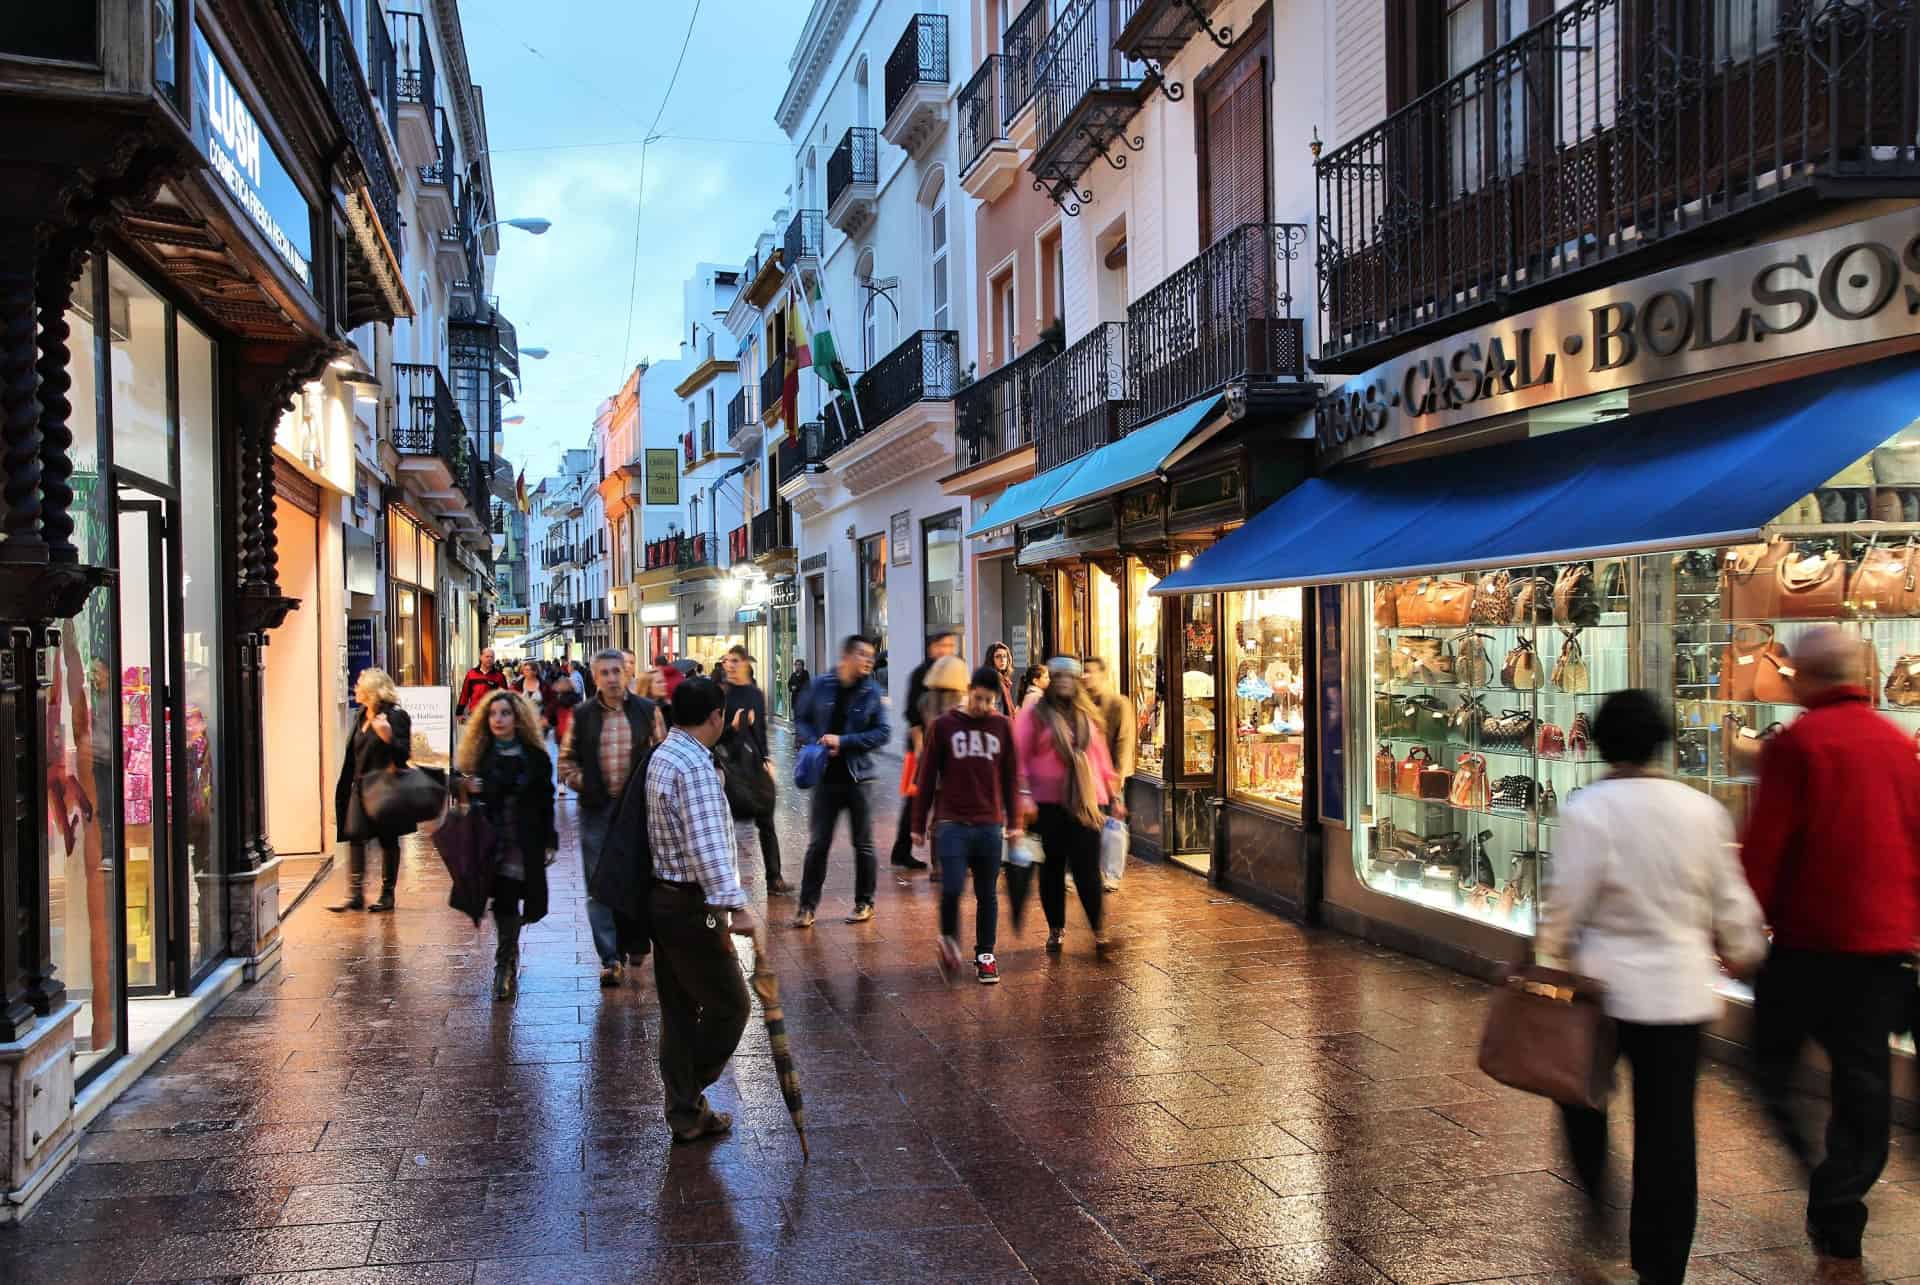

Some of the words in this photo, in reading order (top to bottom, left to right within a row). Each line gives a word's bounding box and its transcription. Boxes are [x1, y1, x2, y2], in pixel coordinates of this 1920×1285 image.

[207, 53, 260, 189] LUSH
[1404, 327, 1556, 418] CASAL
[951, 730, 1001, 760] GAP
